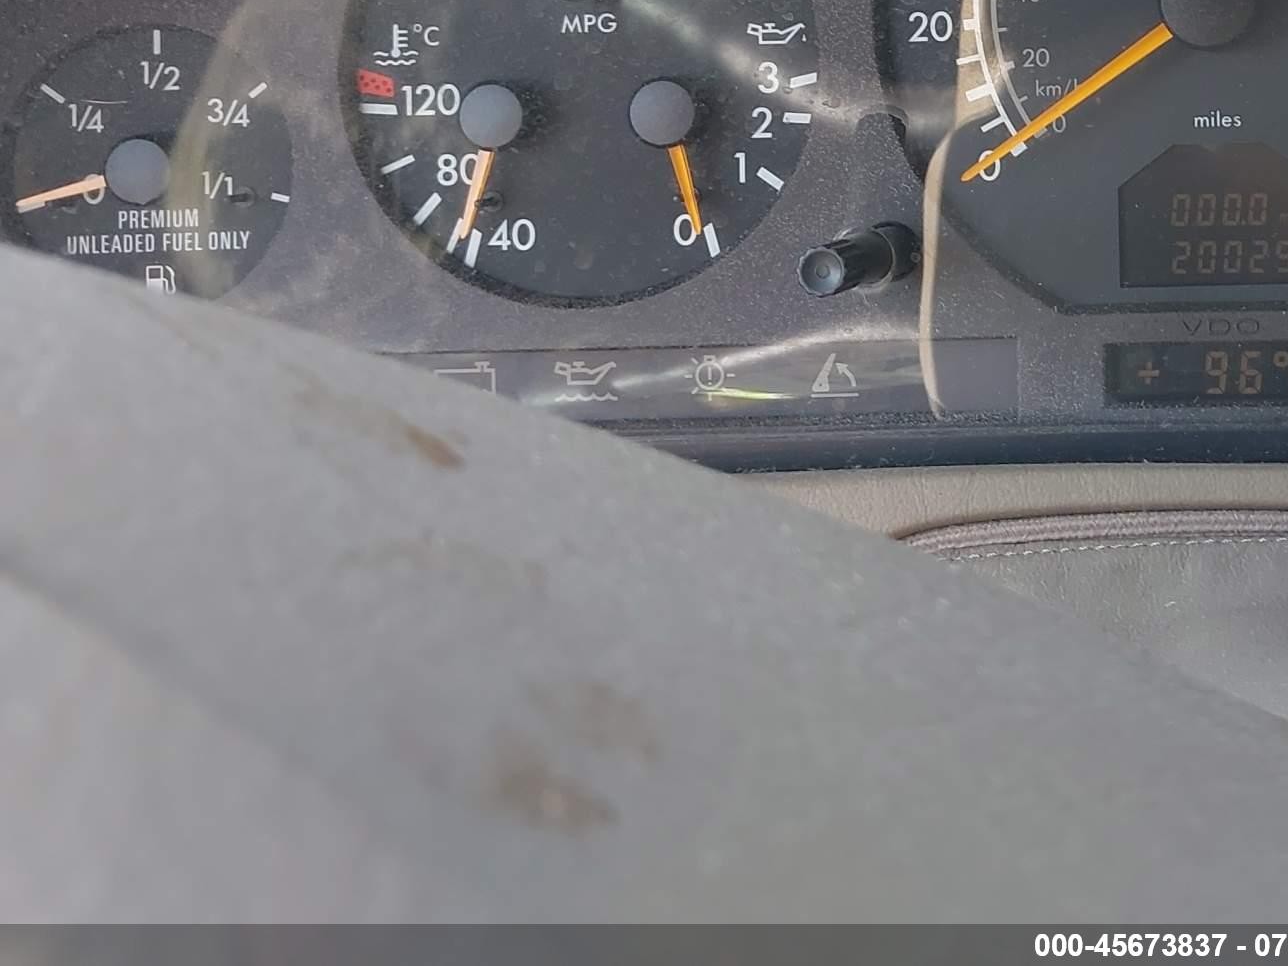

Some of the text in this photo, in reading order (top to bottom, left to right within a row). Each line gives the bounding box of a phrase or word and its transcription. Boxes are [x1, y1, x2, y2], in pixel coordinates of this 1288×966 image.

[413, 24, 440, 46] °C
[562, 14, 617, 33] MPG
[908, 12, 952, 43] 20
[1022, 48, 1049, 68] 20
[141, 61, 180, 91] 1/2
[758, 62, 779, 93] 3
[207, 99, 250, 127] 3/4
[402, 84, 460, 117] 120
[68, 103, 104, 133] 1/4
[752, 107, 773, 139] 2
[1193, 110, 1242, 128] miles
[734, 153, 746, 183] 1
[202, 171, 233, 199] 1/1
[119, 209, 199, 229] PREMIUM
[1171, 193, 1268, 226] 000.0
[67, 231, 250, 255] UNLEADED FUEL ONLY
[488, 219, 536, 251] 40
[674, 214, 699, 246] 0
[1183, 318, 1260, 336] VDO
